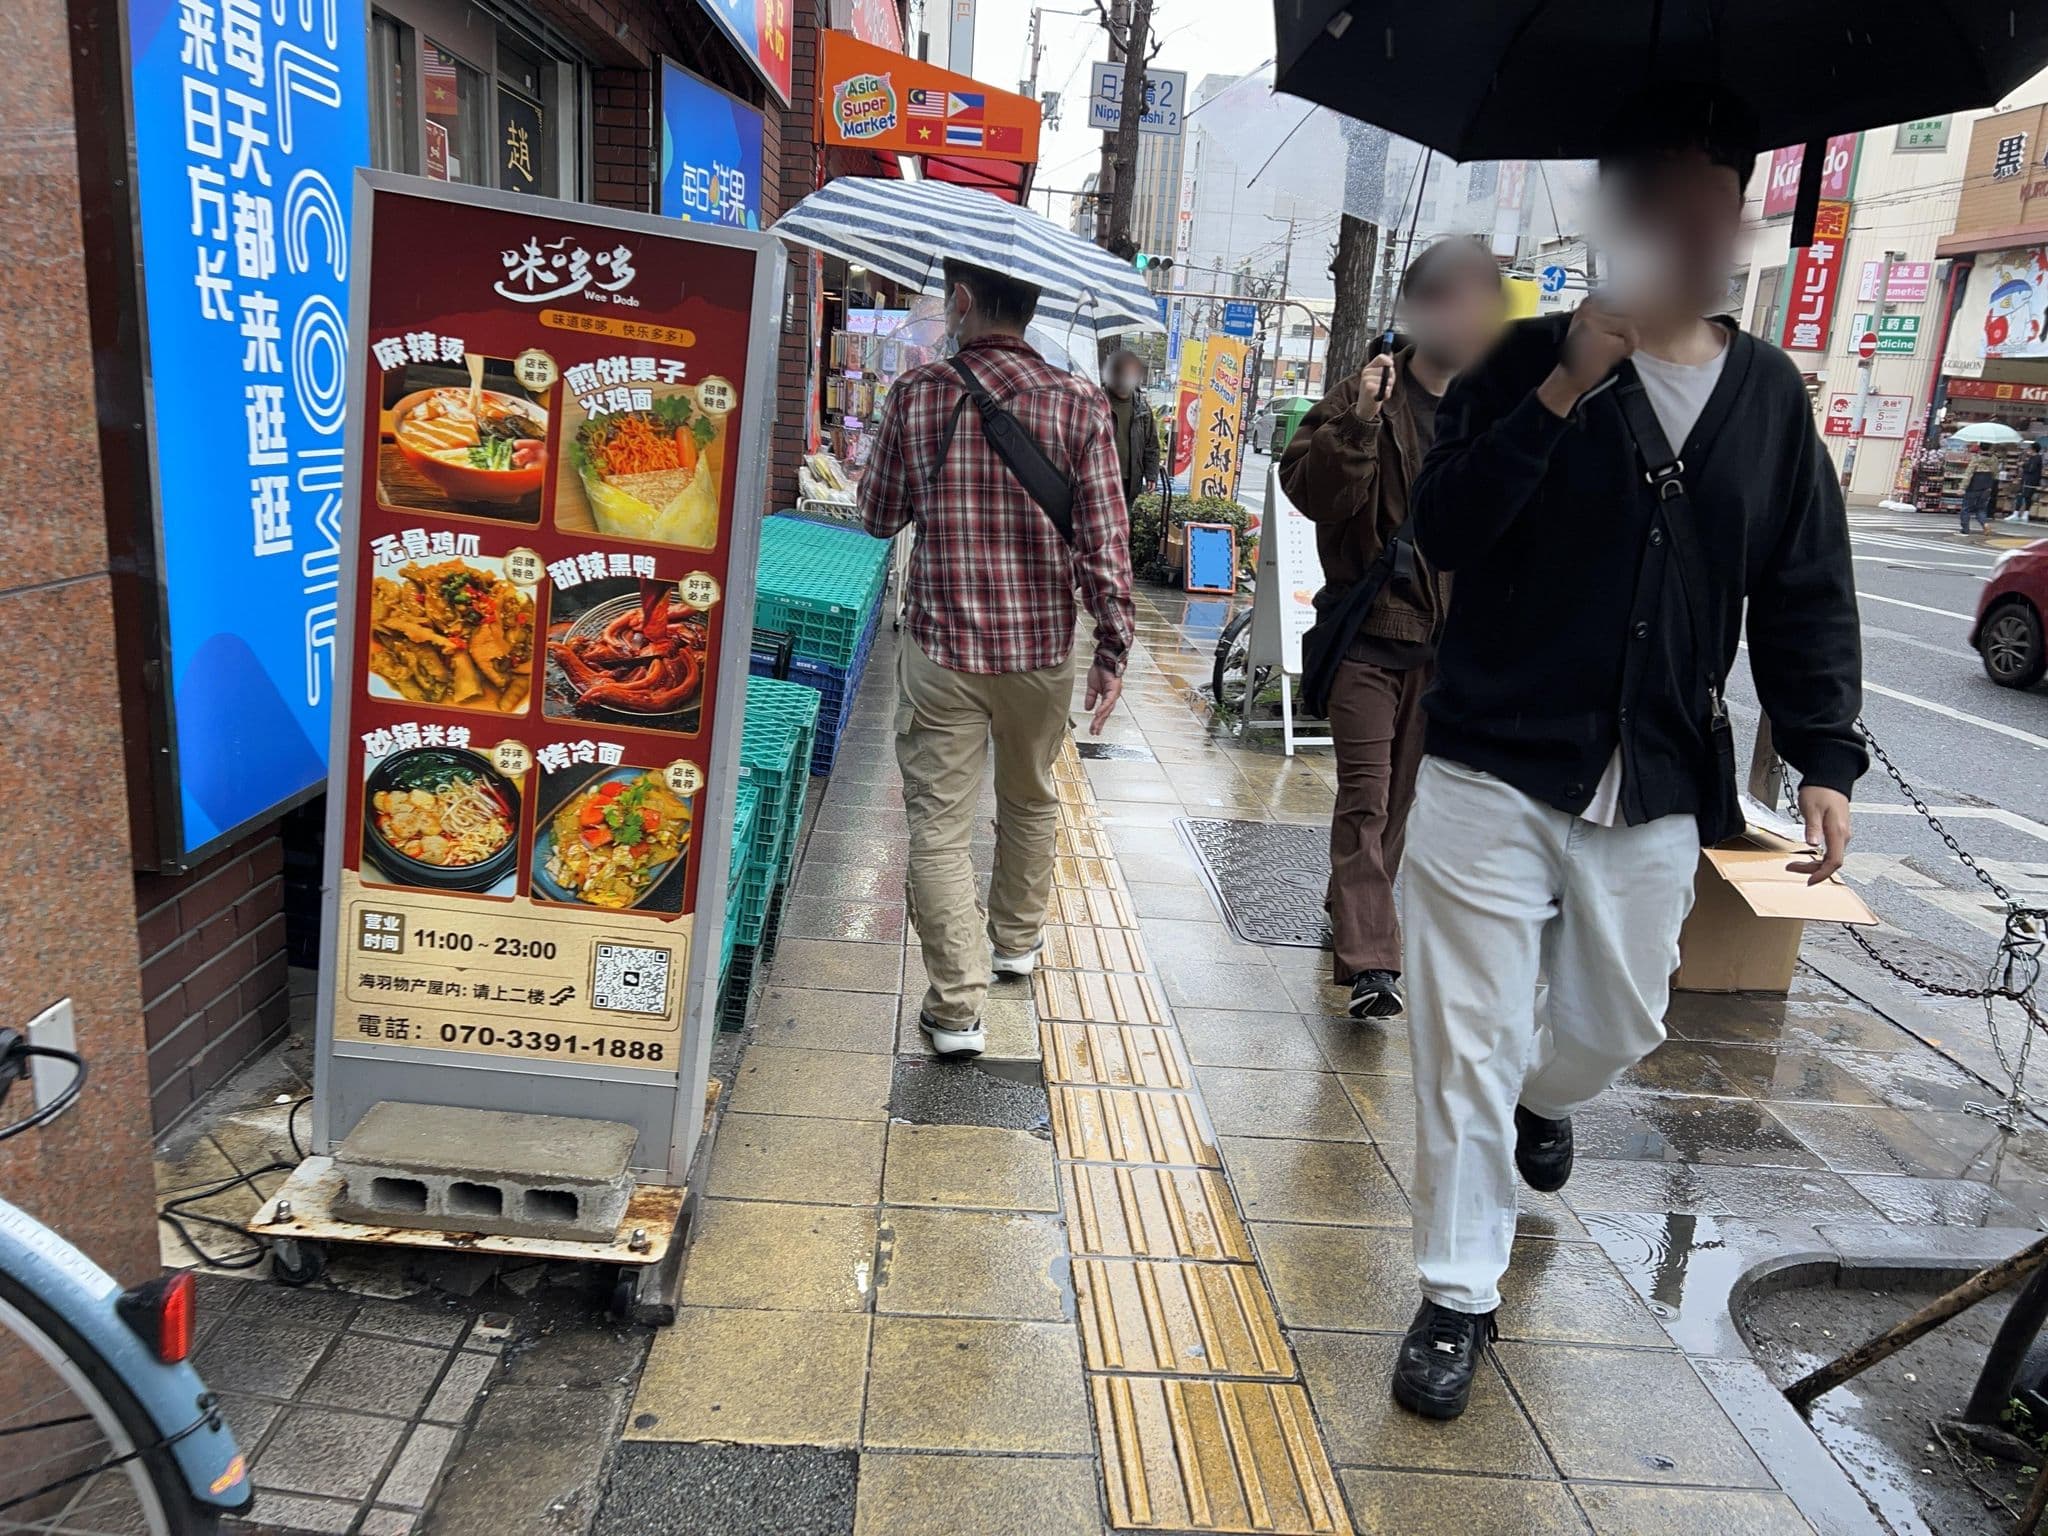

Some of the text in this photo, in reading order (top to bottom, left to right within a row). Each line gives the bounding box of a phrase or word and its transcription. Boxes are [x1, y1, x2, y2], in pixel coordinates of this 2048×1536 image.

[847, 78, 878, 98] Asia
[843, 97, 887, 118] Super
[1095, 104, 1176, 125] Nippashi 2
[843, 113, 896, 138] Market
[179, 0, 234, 322] 来日方长
[584, 290, 640, 308] Wee Dodo
[1791, 241, 1835, 347] キリン堂
[1874, 287, 1927, 297] Csmetics
[371, 331, 464, 371] 麻辣烫
[563, 356, 686, 396] 煎饼果子
[704, 384, 727, 397] 招牌
[579, 387, 652, 420] 火鸡面
[703, 397, 727, 410] 特色
[370, 528, 480, 566] 无骨鸡爪
[546, 552, 656, 590] 甜辣黑鸭
[689, 579, 712, 590] 好评
[688, 592, 710, 602] 必点
[361, 722, 471, 758] 砂锅米线
[536, 739, 625, 774] 烤冷面
[672, 779, 694, 788] 推荐
[673, 768, 695, 778] 店长
[364, 913, 400, 931] 营业
[363, 932, 399, 951] 时间
[414, 929, 473, 952] 11:00
[493, 936, 557, 960] 23:00
[439, 1022, 665, 1062] 070-3391-1888
